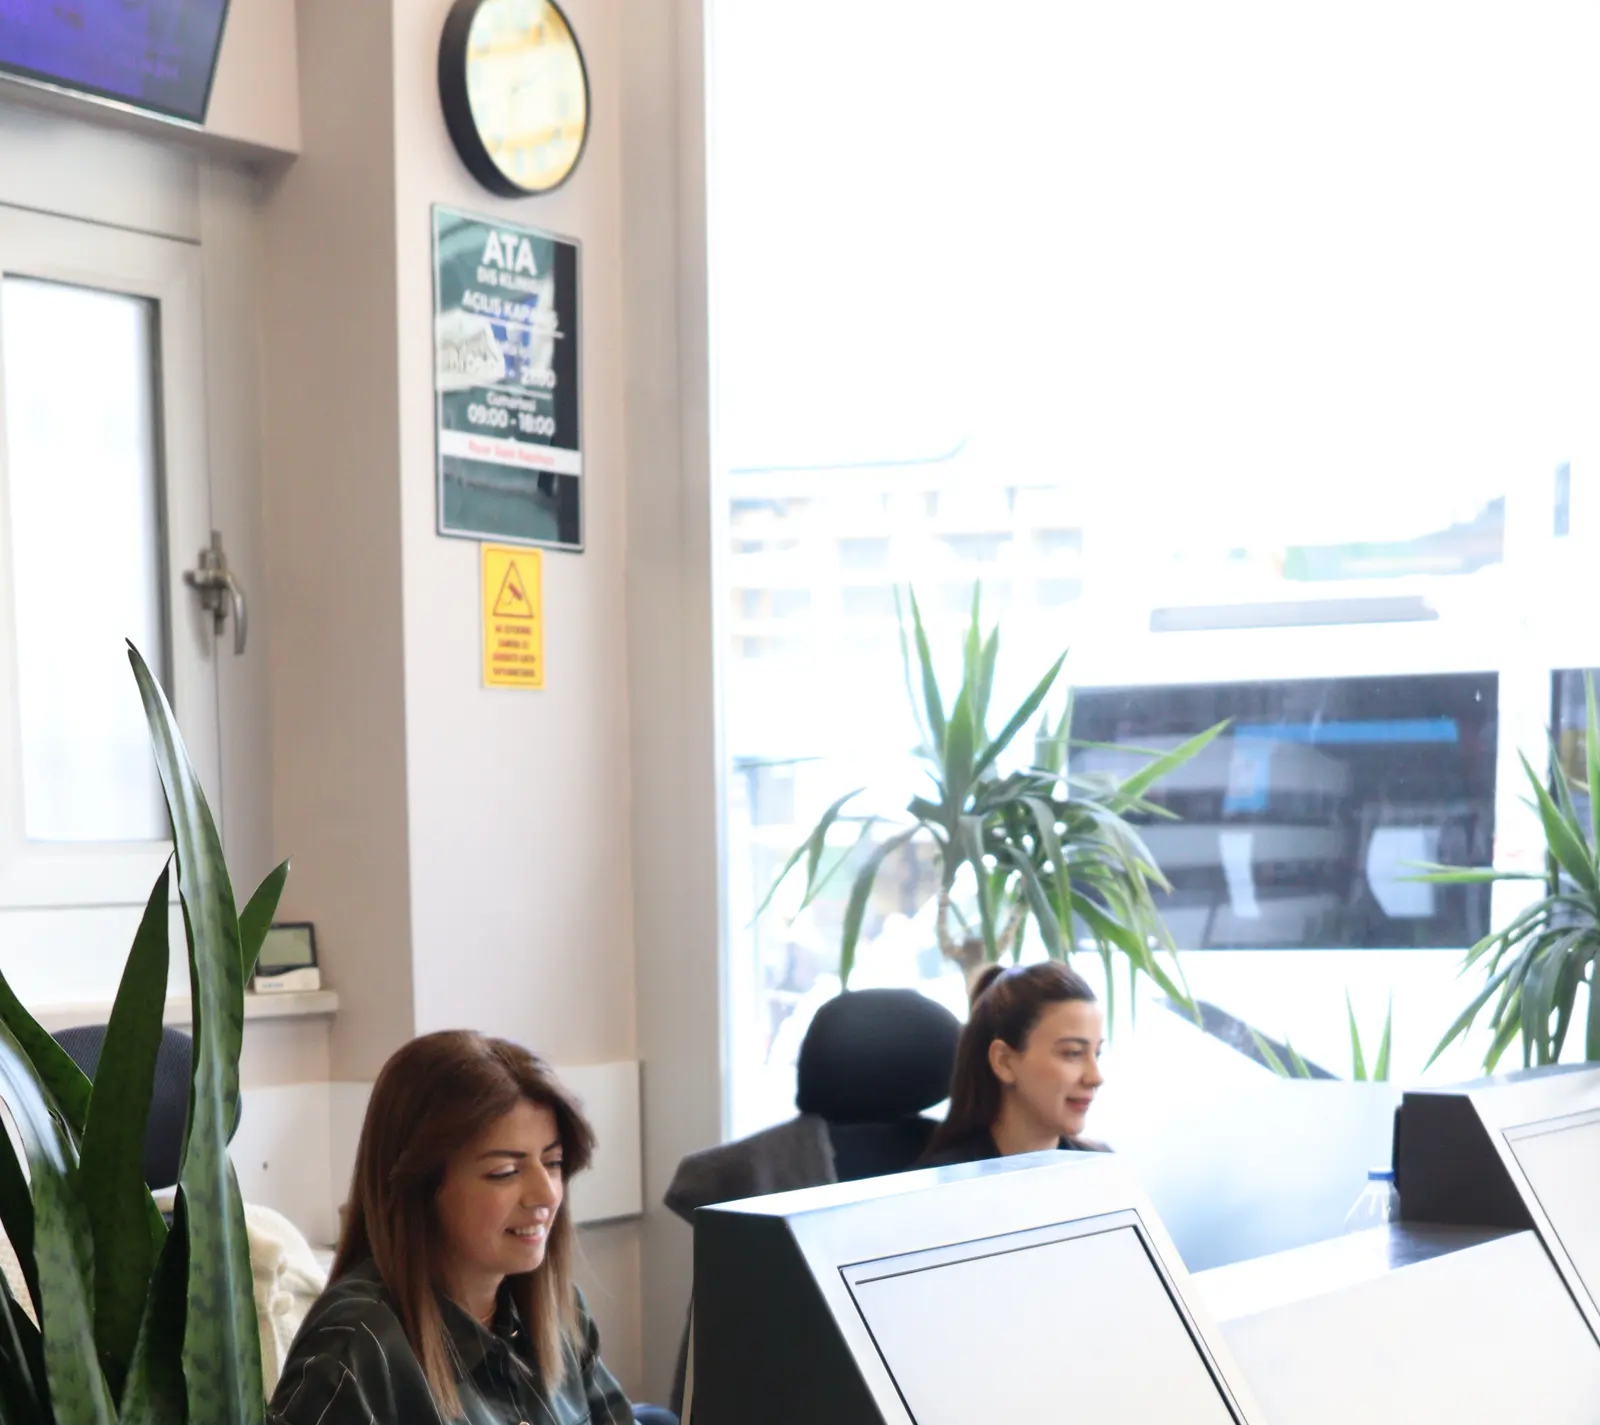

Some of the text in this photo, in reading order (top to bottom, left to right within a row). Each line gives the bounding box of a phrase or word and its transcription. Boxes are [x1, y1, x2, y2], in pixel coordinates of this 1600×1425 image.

[482, 229, 538, 276] ATA
[467, 402, 508, 429] 09:00
[518, 411, 556, 436] 18:00
